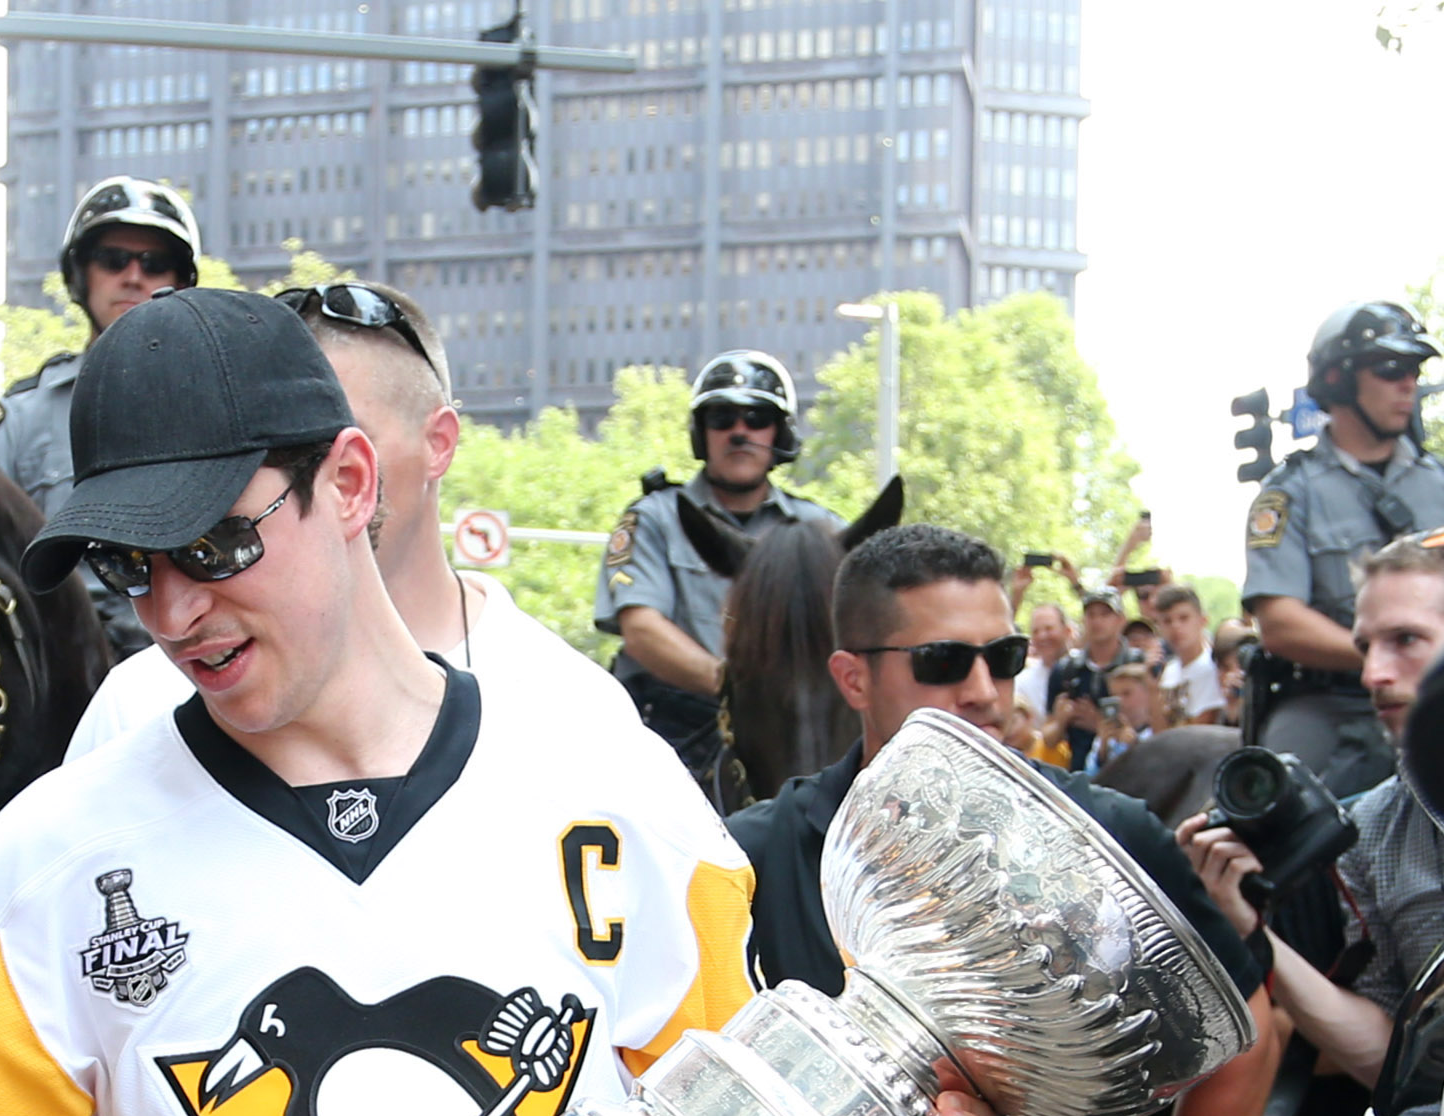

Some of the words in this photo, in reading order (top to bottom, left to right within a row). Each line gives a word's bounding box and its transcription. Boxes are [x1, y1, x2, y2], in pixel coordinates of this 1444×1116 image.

[338, 802, 368, 831] NHL
[557, 820, 623, 966] C
[83, 925, 185, 973] FINAL
[91, 926, 139, 948] STANLEY
[139, 918, 166, 933] CUP
